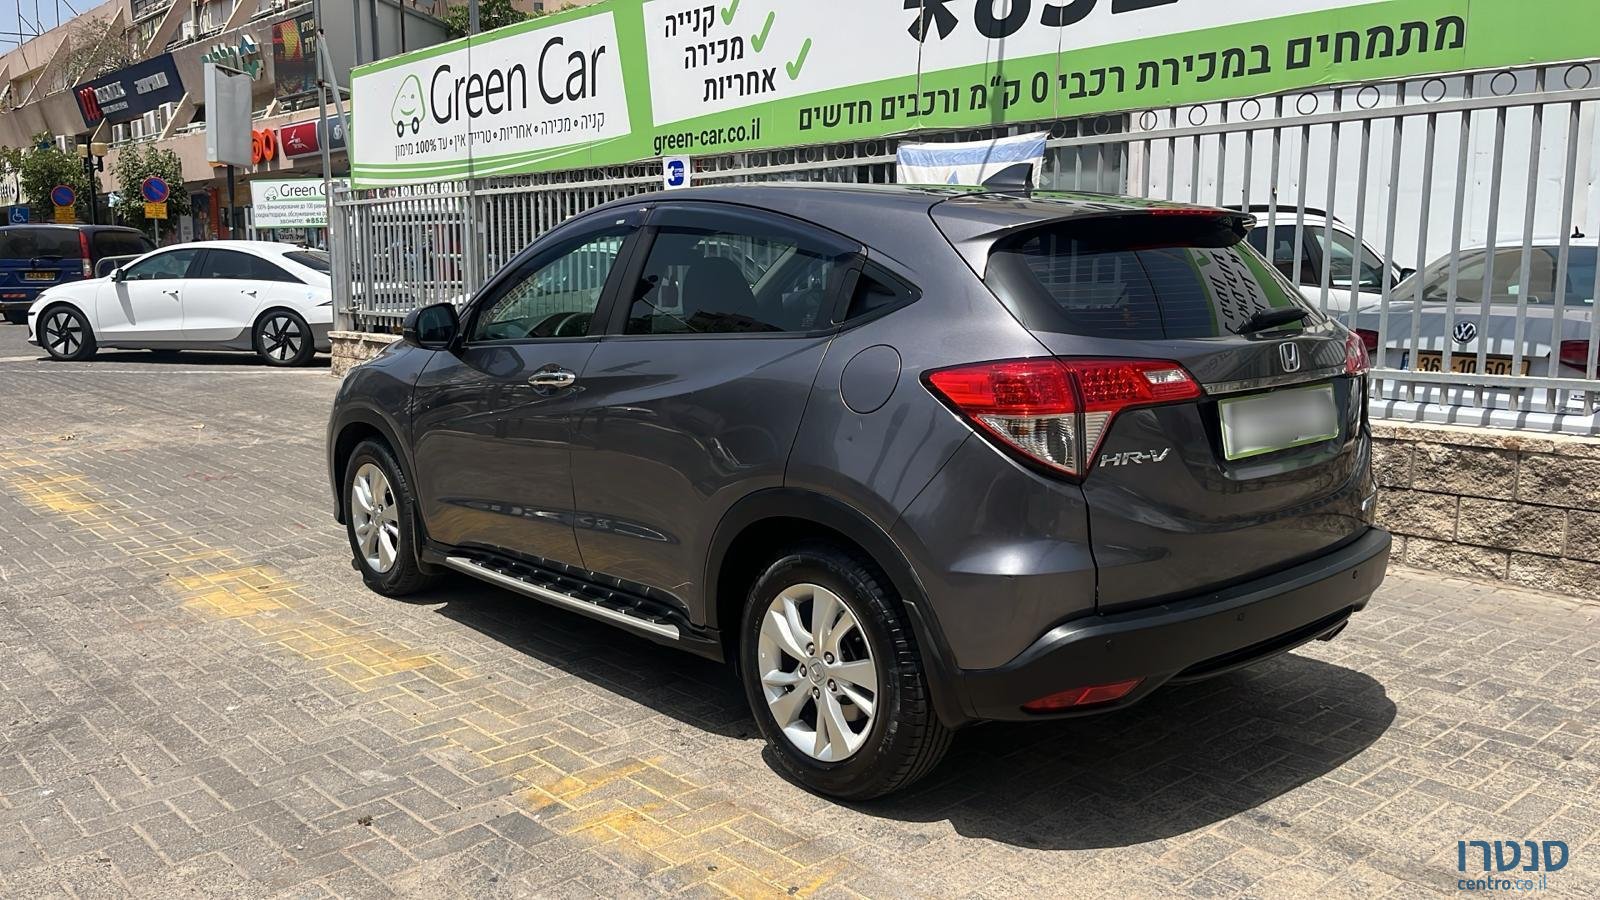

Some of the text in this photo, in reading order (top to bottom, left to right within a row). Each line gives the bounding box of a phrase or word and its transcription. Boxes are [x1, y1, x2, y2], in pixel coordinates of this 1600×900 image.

[665, 5, 715, 38] קנייה
[684, 36, 744, 69] מכירה
[1286, 15, 1465, 70] מתמחים
[430, 36, 606, 125] Green Car
[1058, 66, 1125, 99] רכבי
[1136, 44, 1271, 91] במכירת
[703, 67, 777, 102] אחריות
[1031, 71, 1048, 103] 0
[799, 100, 872, 130] חדשים
[881, 88, 959, 120] ורכבים
[499, 123, 533, 142] אחריות
[541, 117, 571, 140] מכירה
[580, 112, 605, 132] קניה
[653, 117, 761, 155] green-car.co.il
[415, 138, 437, 154] 100%
[438, 137, 448, 150] עד
[280, 183, 317, 197] Green
[1100, 447, 1171, 468] HR-V
